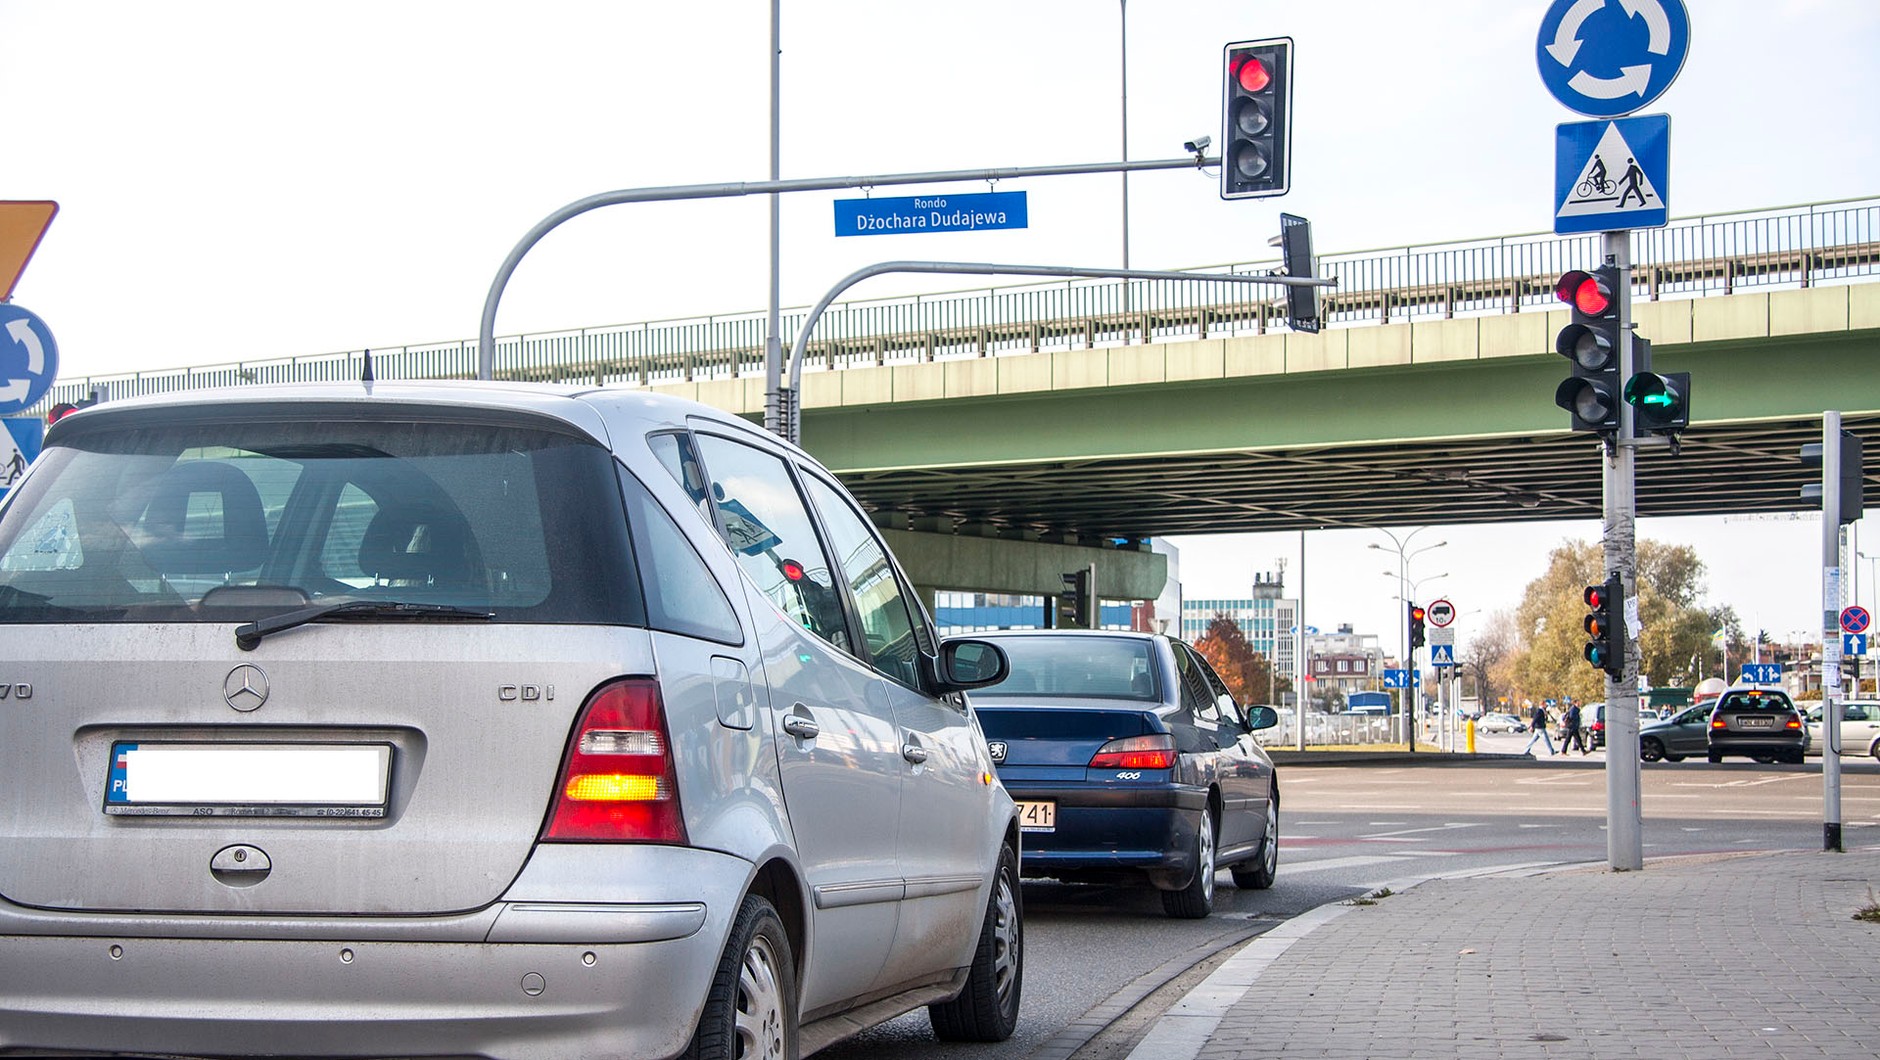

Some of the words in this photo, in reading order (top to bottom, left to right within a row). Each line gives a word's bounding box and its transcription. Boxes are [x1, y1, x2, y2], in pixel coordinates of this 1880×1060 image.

[914, 198, 947, 209] Rondo
[857, 213, 926, 230] Dżochara
[931, 210, 1007, 229] Dudajewa
[498, 684, 555, 701] CDI
[1116, 771, 1141, 780] 406
